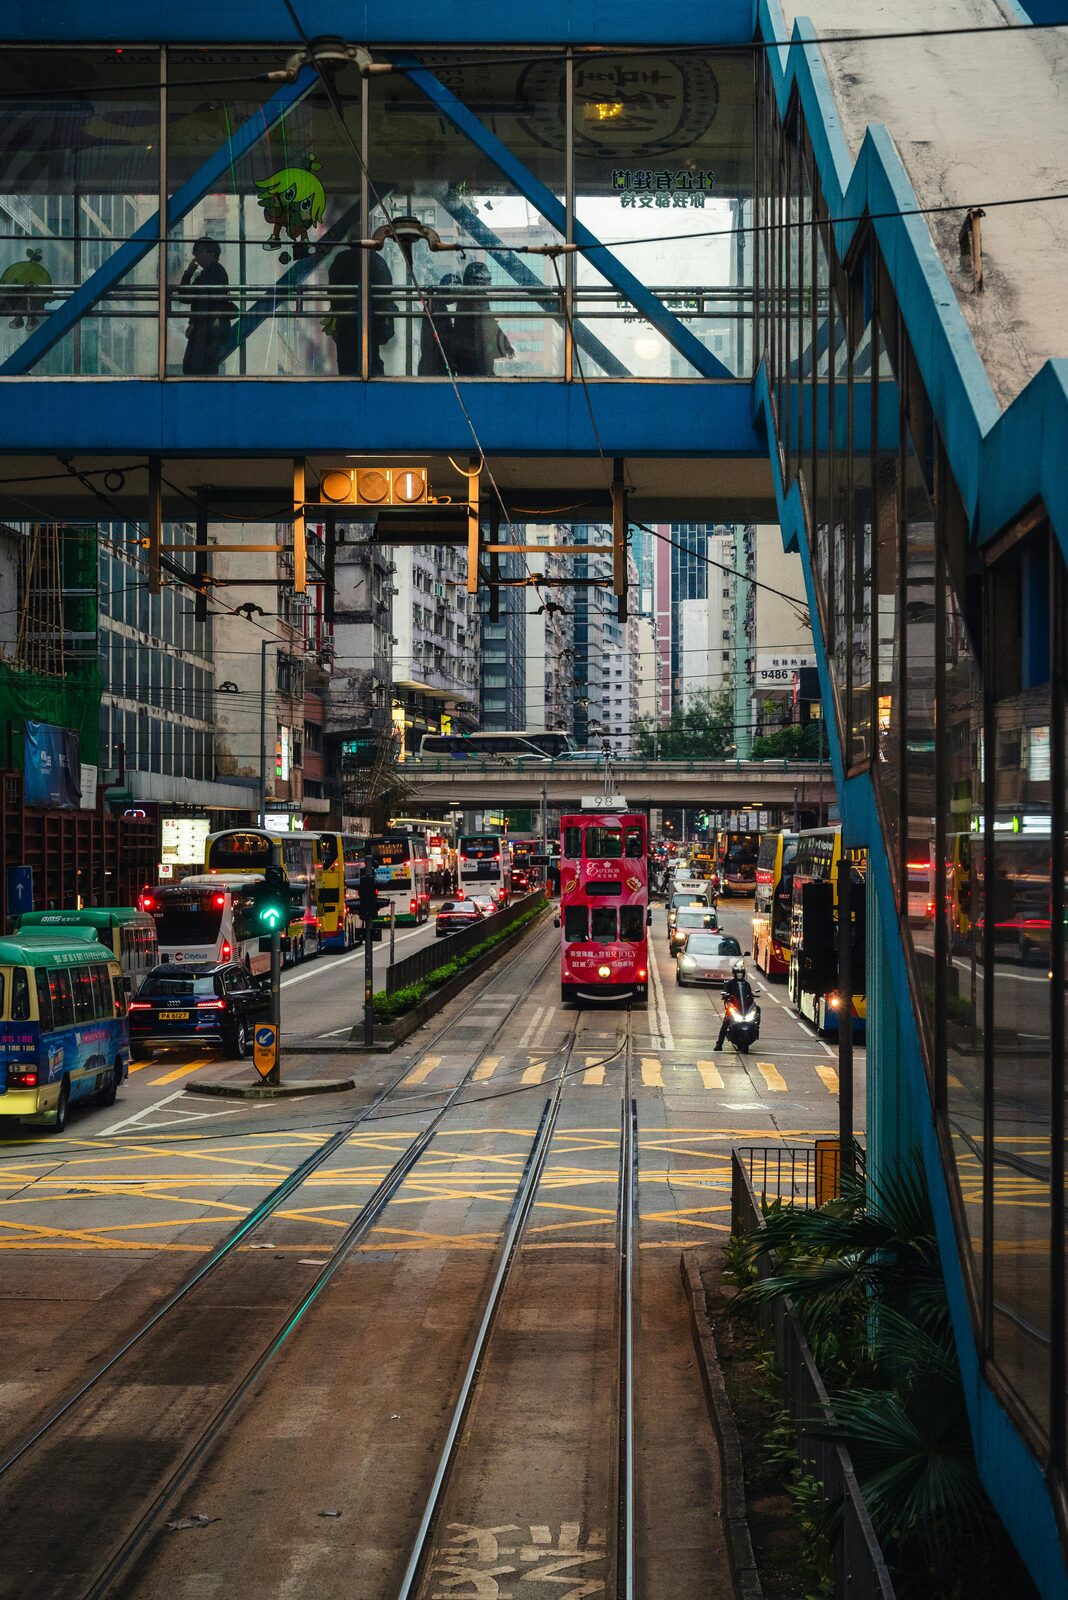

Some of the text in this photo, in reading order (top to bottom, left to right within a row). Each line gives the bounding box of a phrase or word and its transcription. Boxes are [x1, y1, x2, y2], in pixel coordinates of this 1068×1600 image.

[762, 670, 788, 679] 9486
[594, 796, 613, 807] 98
[184, 952, 208, 960] Citybus
[618, 950, 638, 959] JOEY
